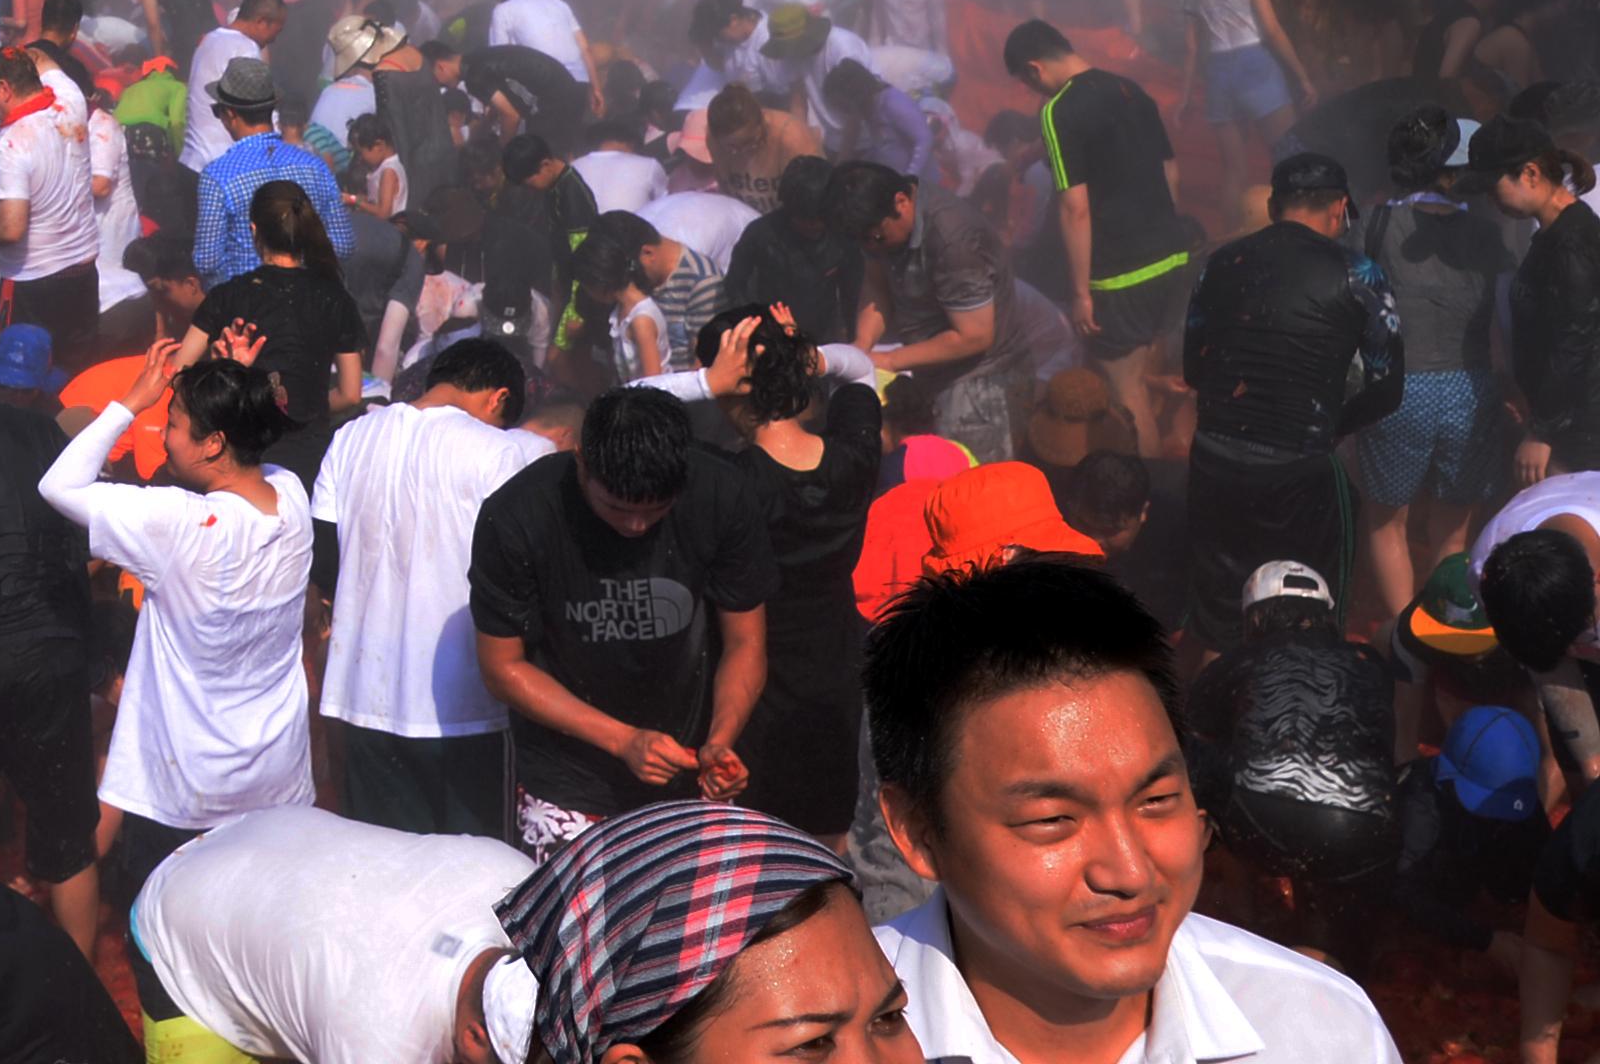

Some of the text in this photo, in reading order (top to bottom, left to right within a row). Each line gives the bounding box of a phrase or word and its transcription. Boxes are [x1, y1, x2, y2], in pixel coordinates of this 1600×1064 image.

[600, 578, 649, 600] THE
[565, 596, 652, 622] NORTH
[591, 618, 655, 642] FACE
